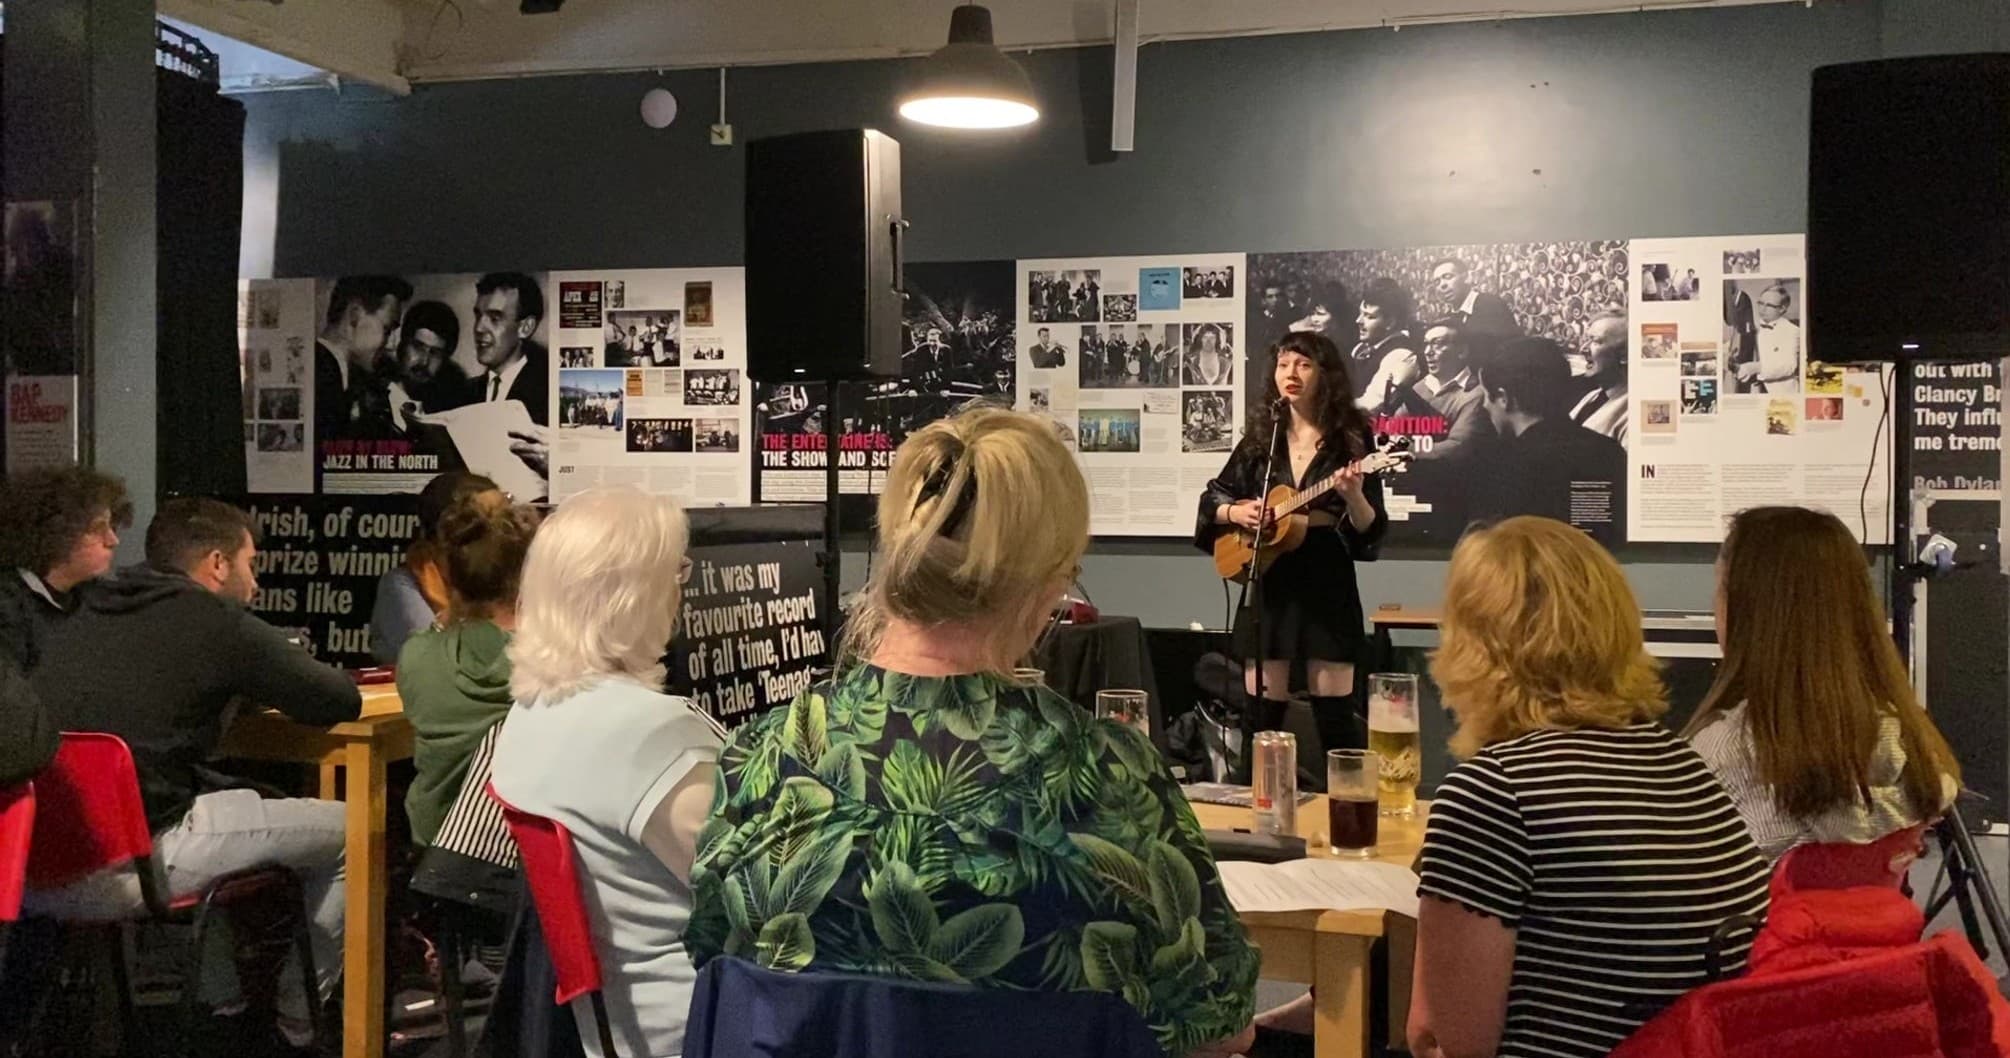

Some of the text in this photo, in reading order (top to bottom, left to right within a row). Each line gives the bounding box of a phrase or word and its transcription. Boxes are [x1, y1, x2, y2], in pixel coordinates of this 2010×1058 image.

[1914, 362, 1993, 378] out with
[1914, 385, 1977, 406] Clancy
[1913, 408, 1958, 429] They
[763, 433, 787, 449] THE
[1411, 435, 1434, 453] TO
[1914, 435, 1942, 450] me
[322, 454, 438, 470] JAZZ IN THE NORTH
[761, 450, 787, 467] THE
[871, 450, 897, 467] SCE
[1641, 464, 1655, 479] IN
[1913, 475, 1948, 489] Bob
[323, 506, 353, 538] of
[358, 513, 421, 539] cour
[256, 543, 319, 578] prize
[701, 560, 717, 595] it
[720, 563, 754, 593] was
[757, 562, 781, 595] my
[251, 582, 353, 614] ans like
[683, 587, 816, 640] favourite record
[327, 621, 371, 653] but
[688, 642, 706, 681] of
[713, 638, 736, 676] all
[738, 634, 780, 670] time,
[781, 627, 800, 662] I'd
[716, 677, 755, 717] take
